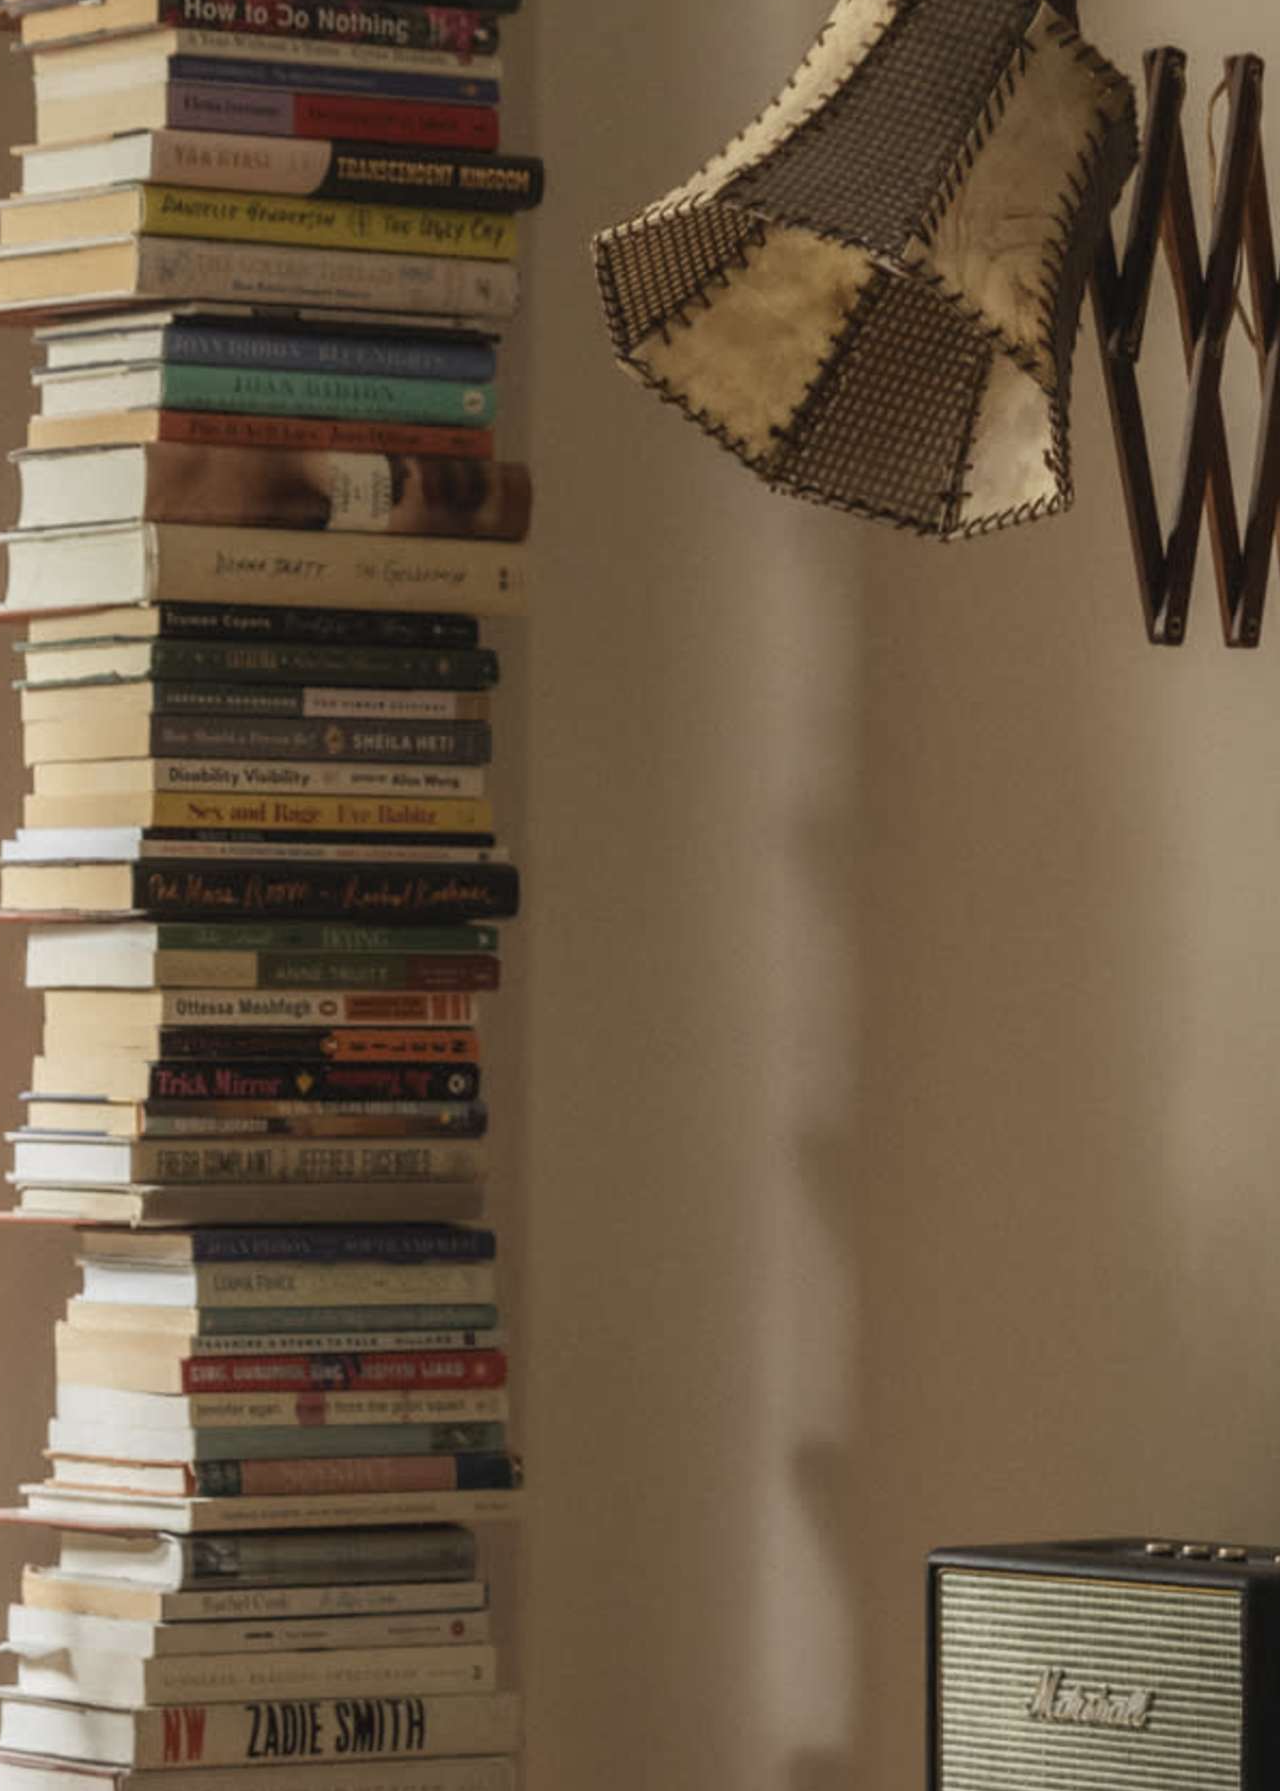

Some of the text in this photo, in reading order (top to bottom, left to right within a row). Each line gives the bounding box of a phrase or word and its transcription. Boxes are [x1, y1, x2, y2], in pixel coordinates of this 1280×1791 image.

[244, 2, 268, 25] to
[317, 7, 410, 44] Nothing
[352, 732, 456, 754] SHEILA HETI
[168, 765, 311, 788] Disability Visibility
[188, 801, 322, 824] Sex and Rage
[175, 996, 234, 1015] Ottessa
[155, 1068, 283, 1097] Trick Mirror
[1027, 1665, 1156, 1731] Marshall
[162, 1697, 427, 1763] NW ZADIE SMITH
